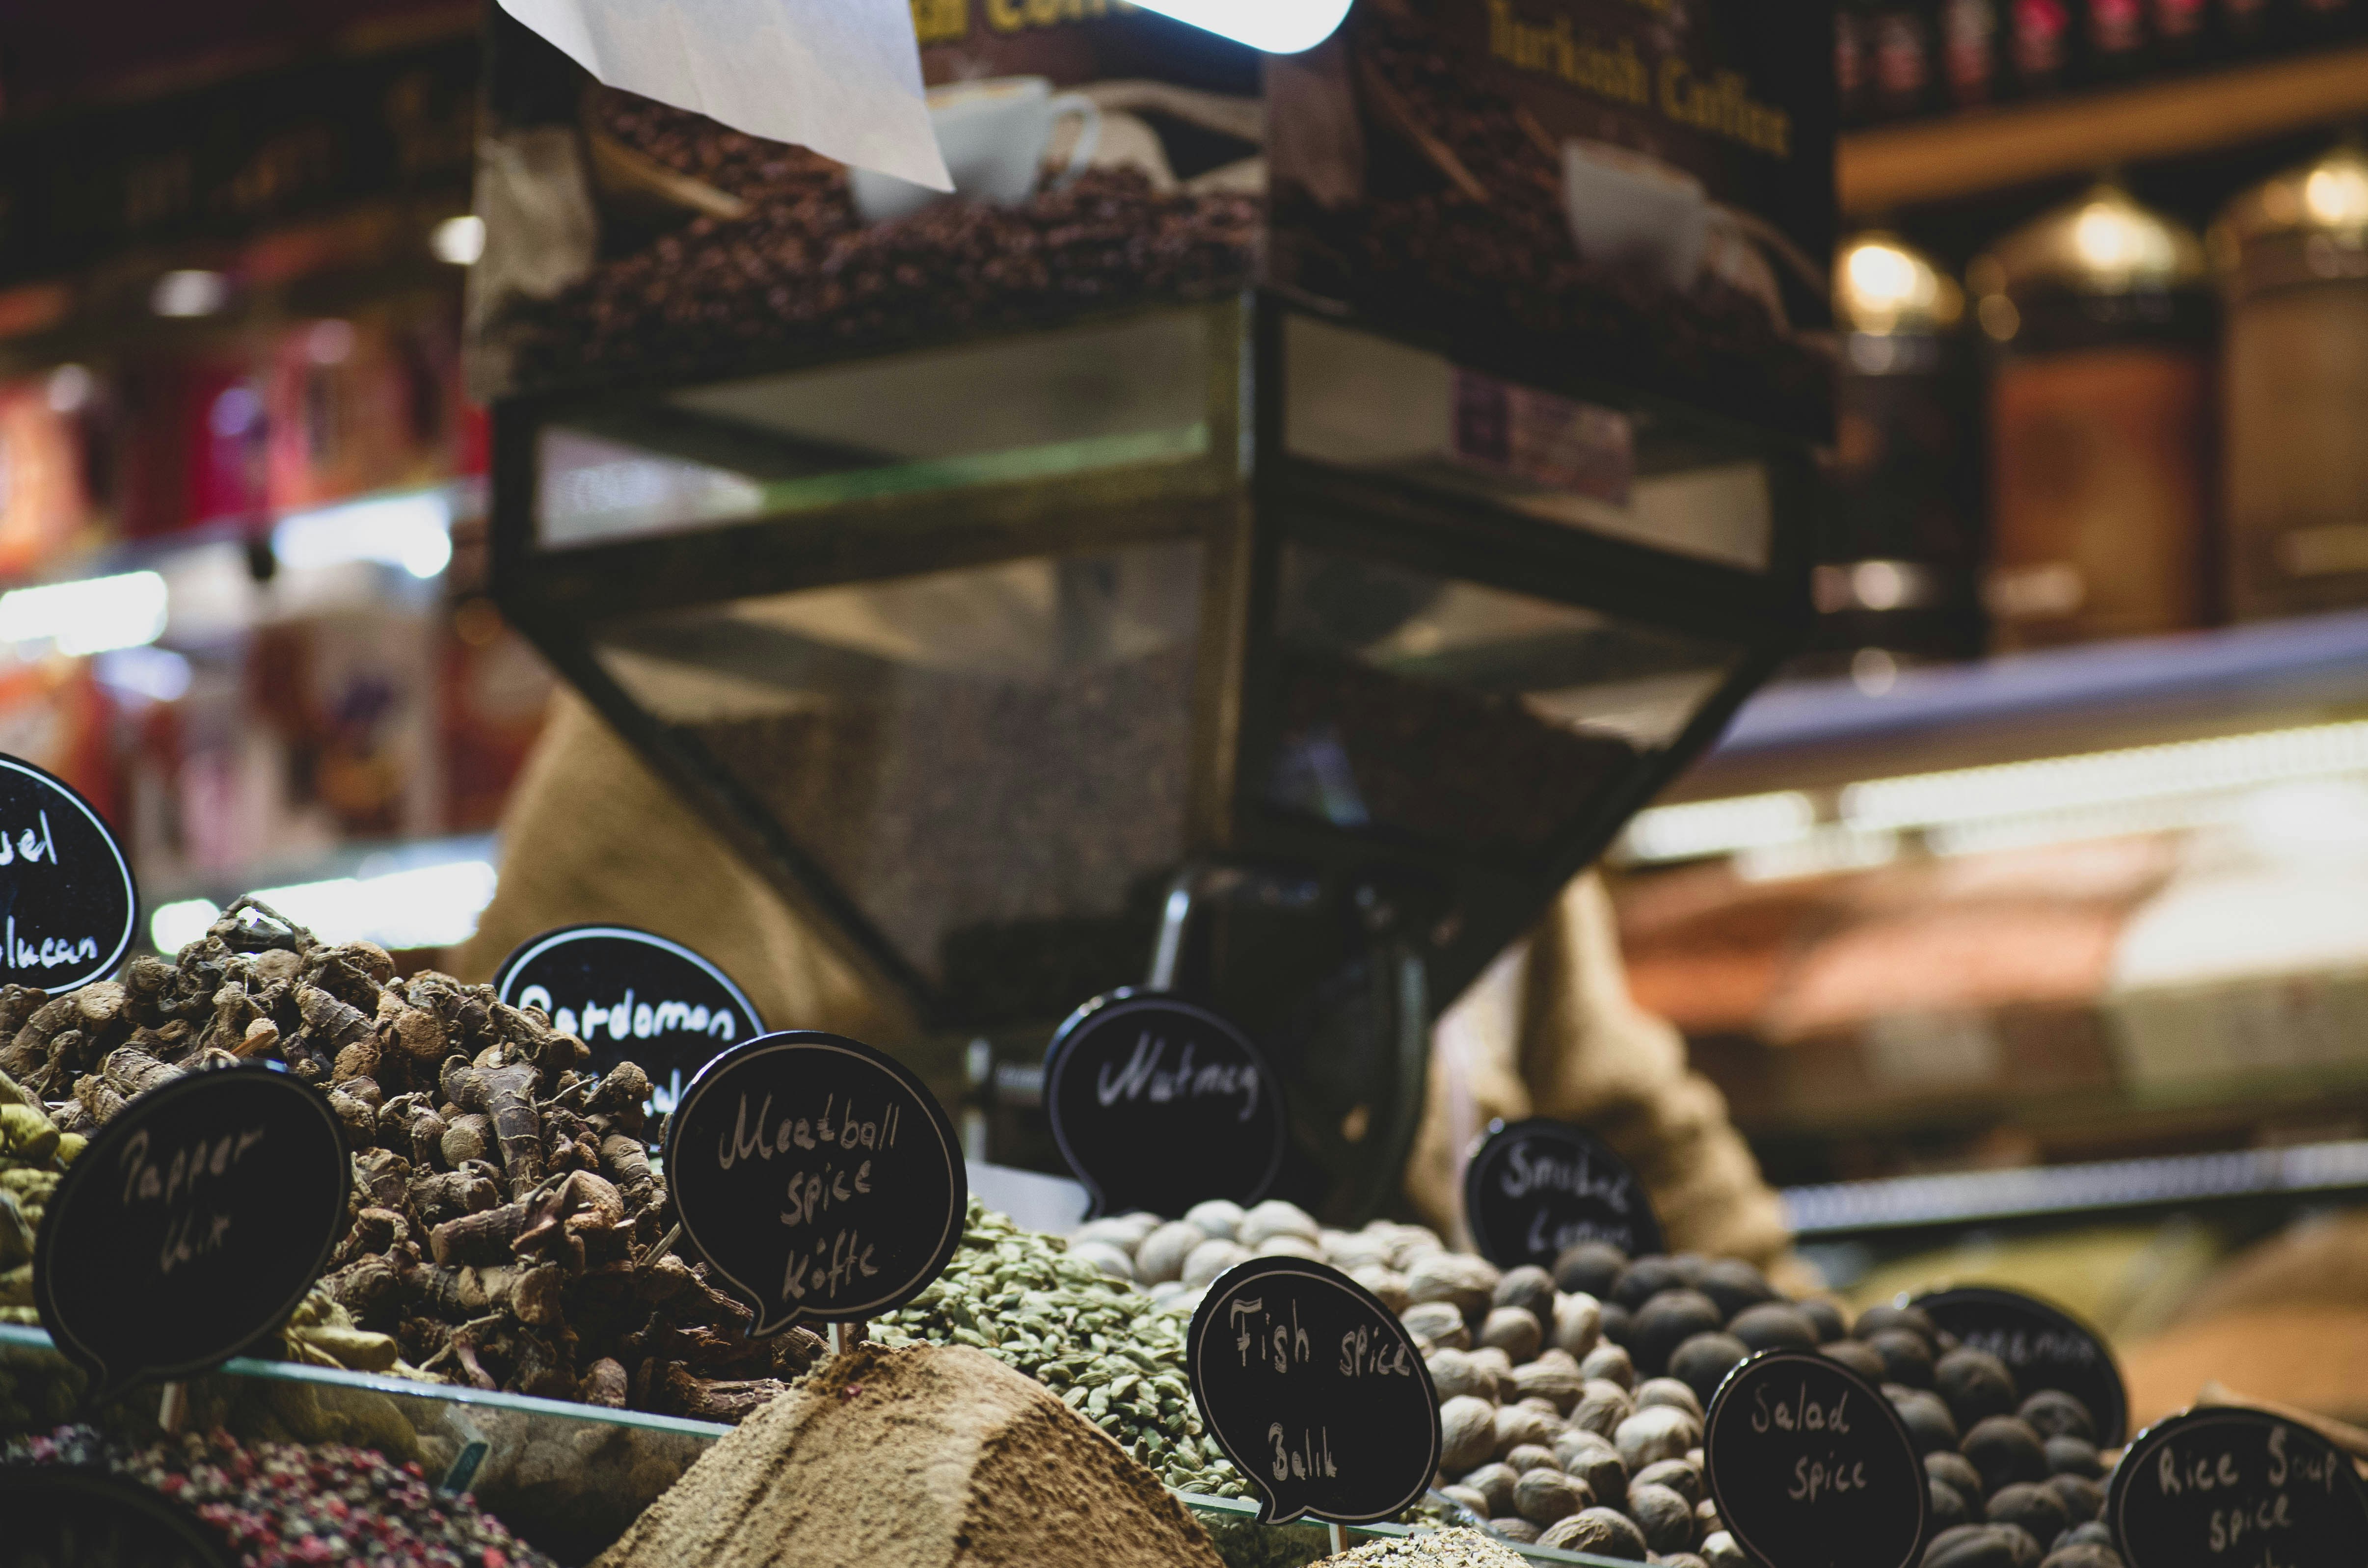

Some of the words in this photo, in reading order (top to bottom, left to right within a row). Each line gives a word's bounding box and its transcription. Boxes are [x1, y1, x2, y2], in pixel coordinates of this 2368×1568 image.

[718, 1090, 900, 1170] Meatball
[1230, 1297, 1310, 1374] Fish
[1751, 1380, 1850, 1434] Salad
[2158, 1445, 2240, 1496] Rice
